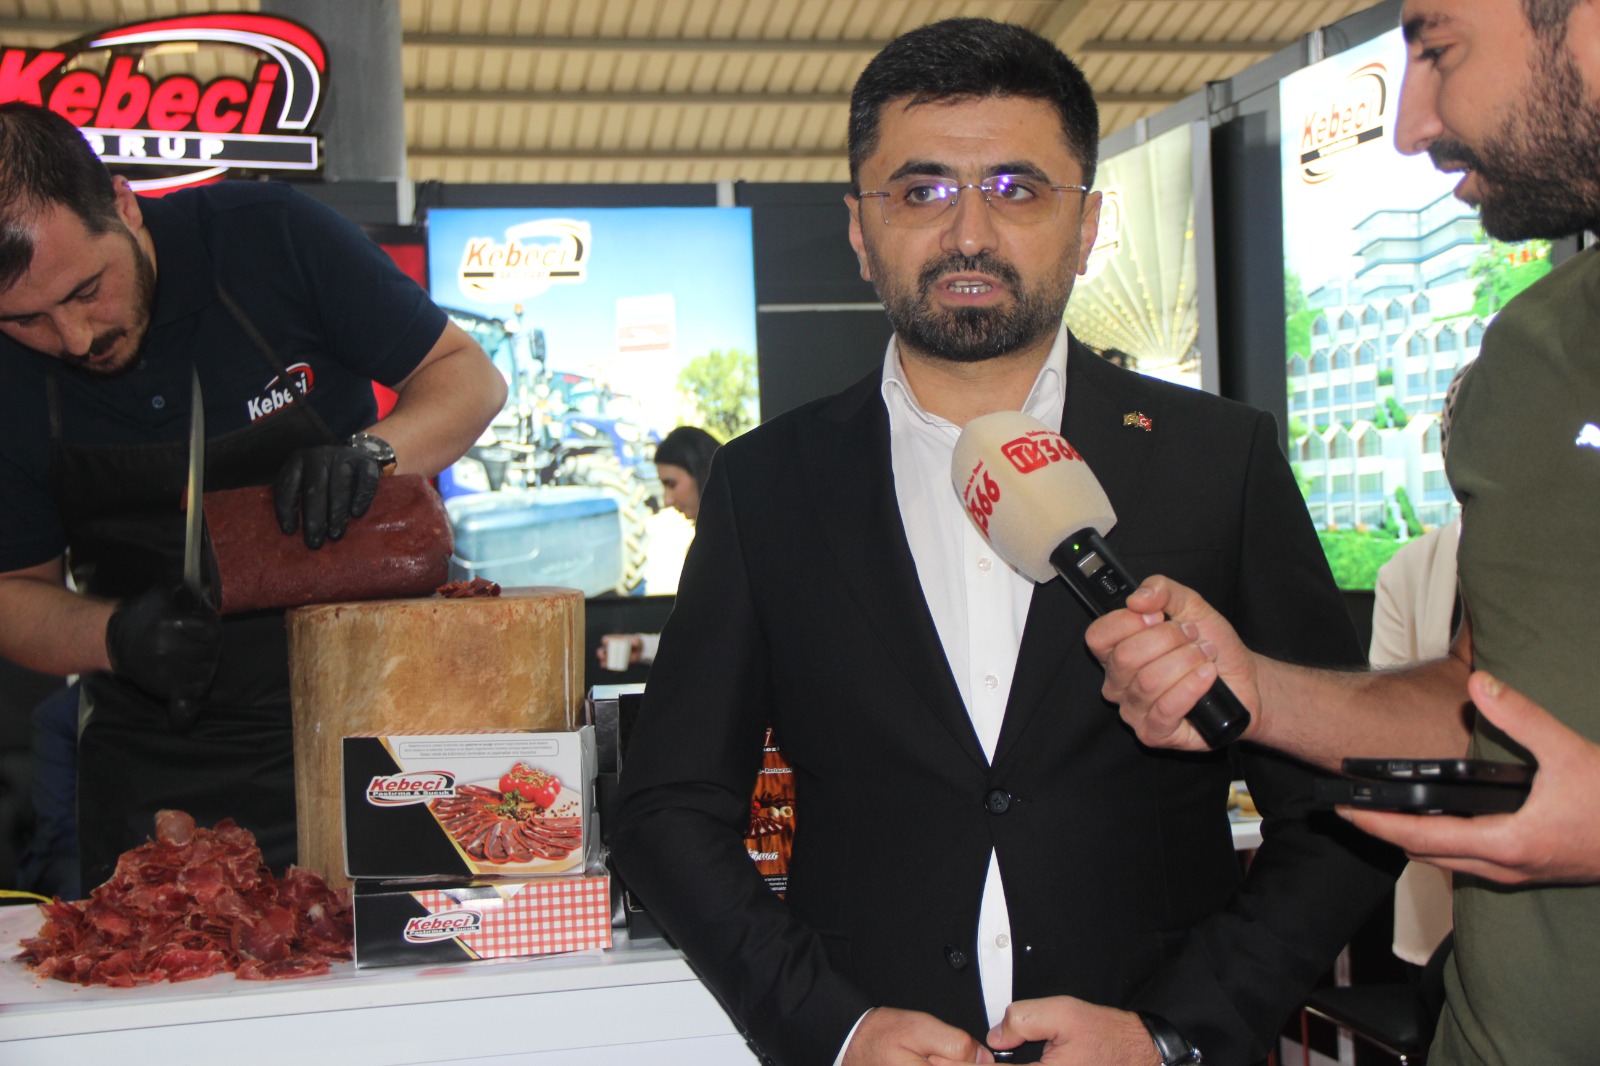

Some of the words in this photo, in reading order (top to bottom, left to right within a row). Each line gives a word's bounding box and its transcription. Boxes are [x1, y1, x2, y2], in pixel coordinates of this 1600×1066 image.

[0, 49, 280, 134] Kebeci
[247, 372, 307, 421] Kebei
[370, 777, 444, 791] Kebeci
[407, 915, 471, 931] Kebeci
